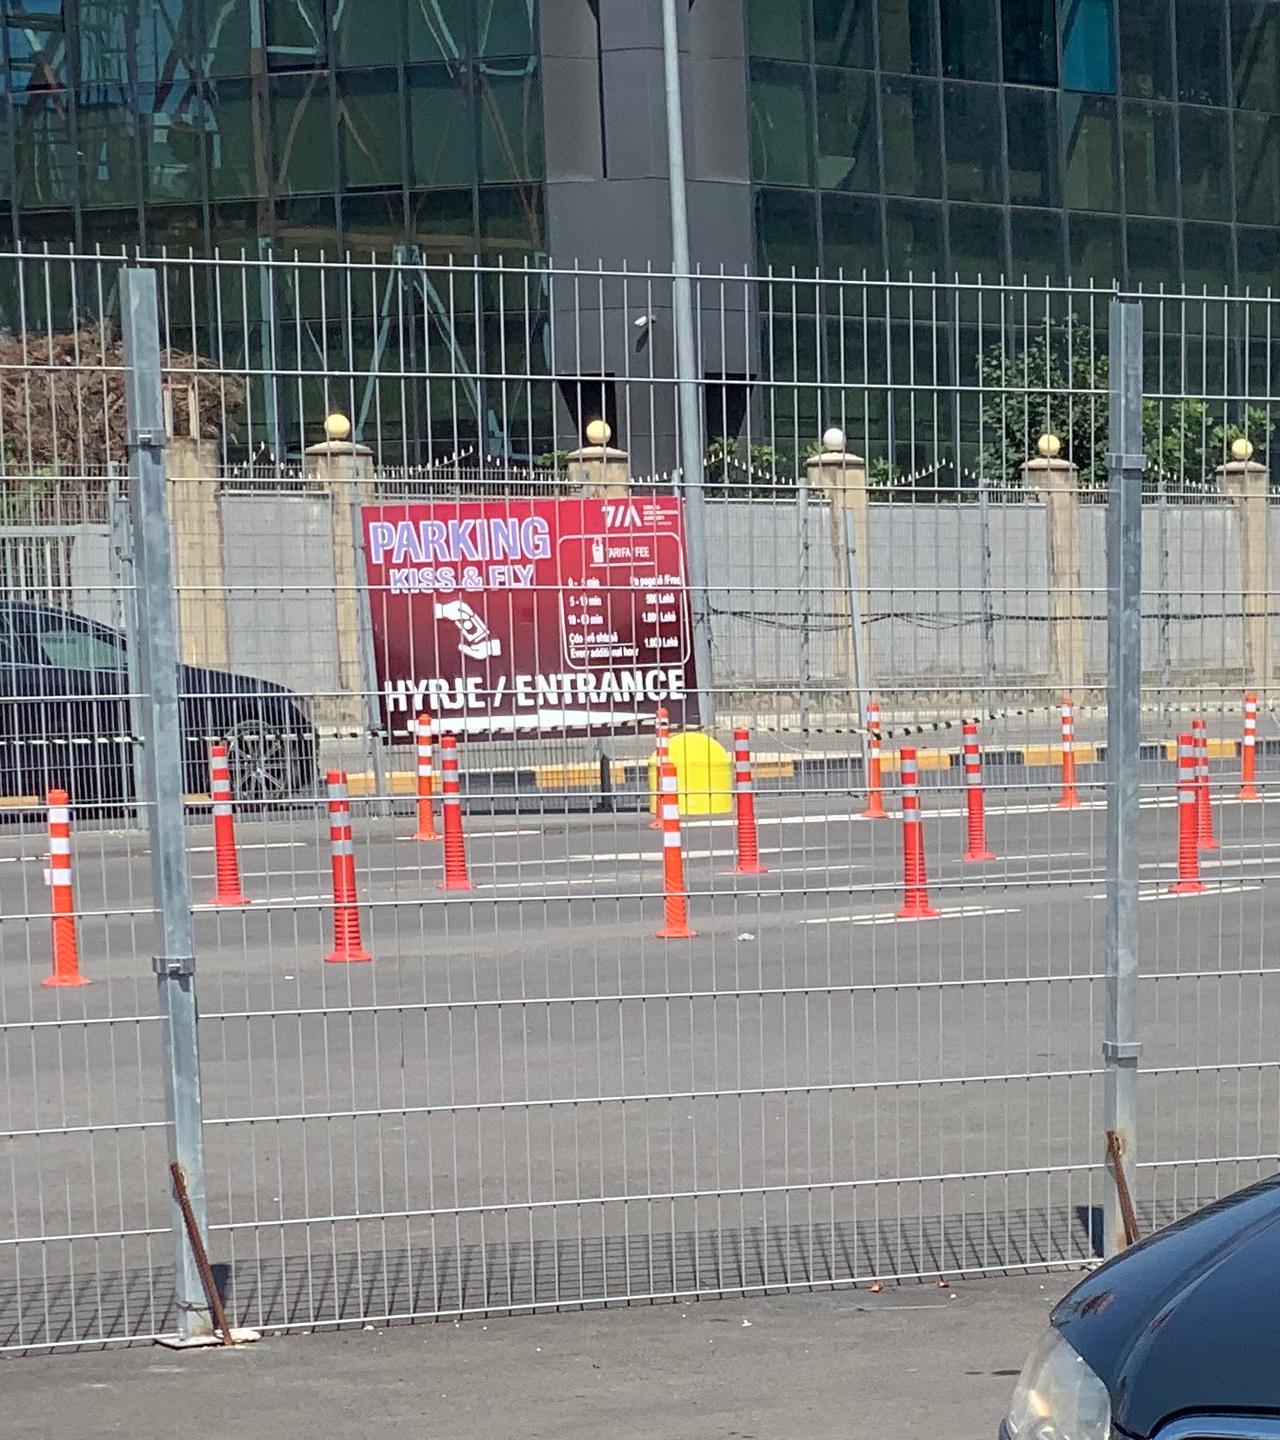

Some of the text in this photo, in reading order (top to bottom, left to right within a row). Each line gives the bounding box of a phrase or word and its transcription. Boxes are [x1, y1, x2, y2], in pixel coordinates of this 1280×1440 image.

[369, 515, 551, 564] PARKING
[635, 546, 650, 557] FEE
[389, 564, 534, 595] KISS & FLY
[383, 669, 687, 712] HYRJE / ENTRANCE
